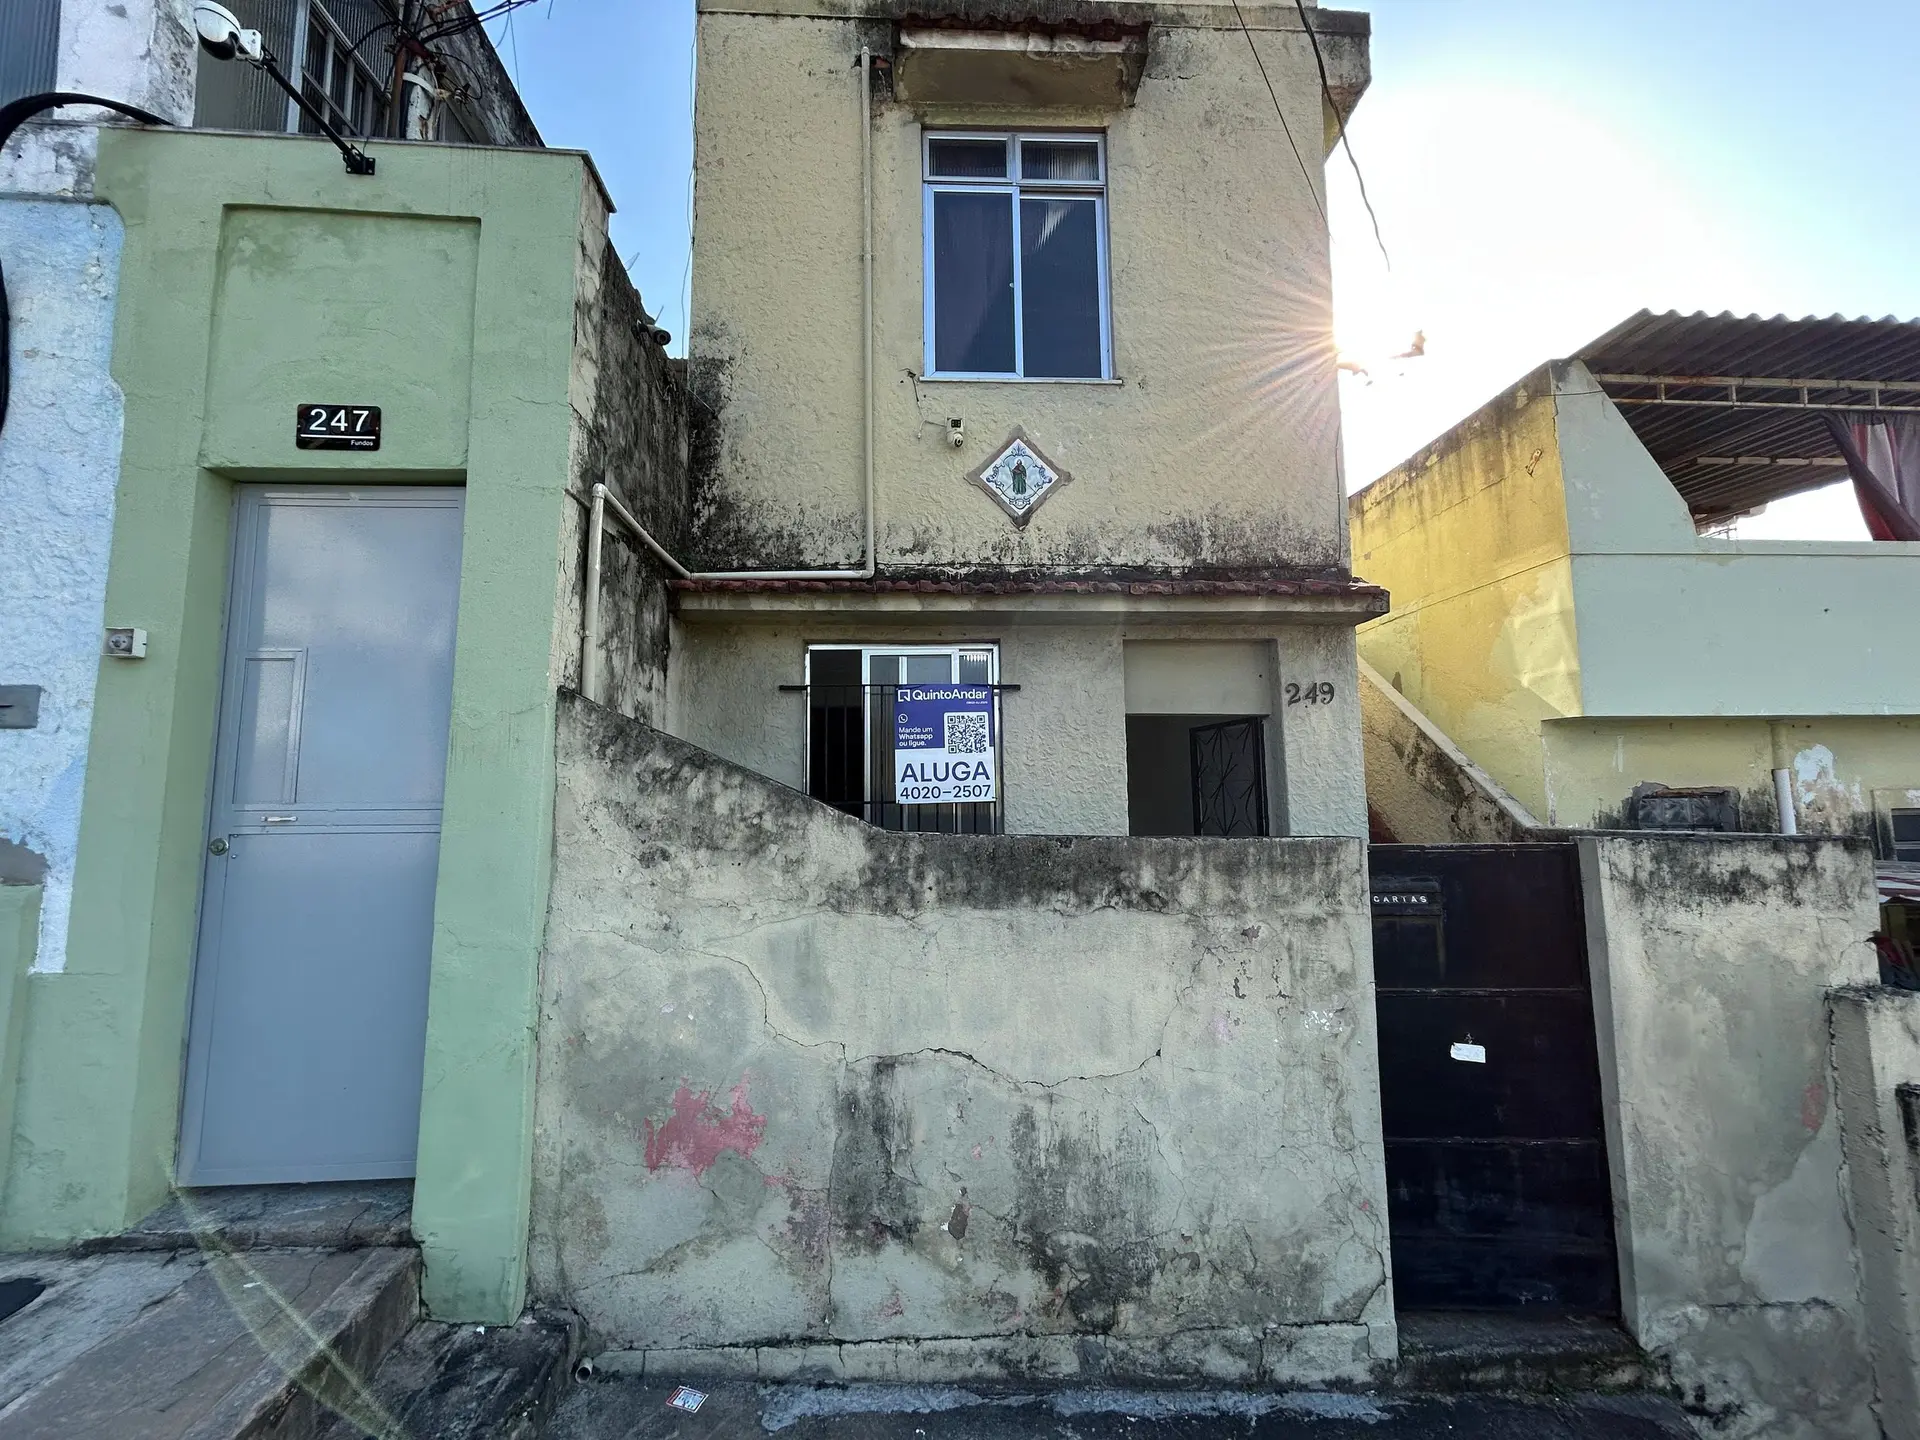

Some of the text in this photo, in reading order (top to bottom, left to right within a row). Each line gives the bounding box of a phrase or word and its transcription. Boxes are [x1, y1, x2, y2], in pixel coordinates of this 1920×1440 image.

[309, 408, 369, 432] 247
[912, 688, 988, 701] QuintoAndar
[1285, 681, 1335, 707] 249
[908, 739, 927, 747] ligue.
[900, 761, 991, 783] ALUGA
[900, 784, 991, 800] 4020-2507
[1373, 895, 1427, 903] CARTAS
